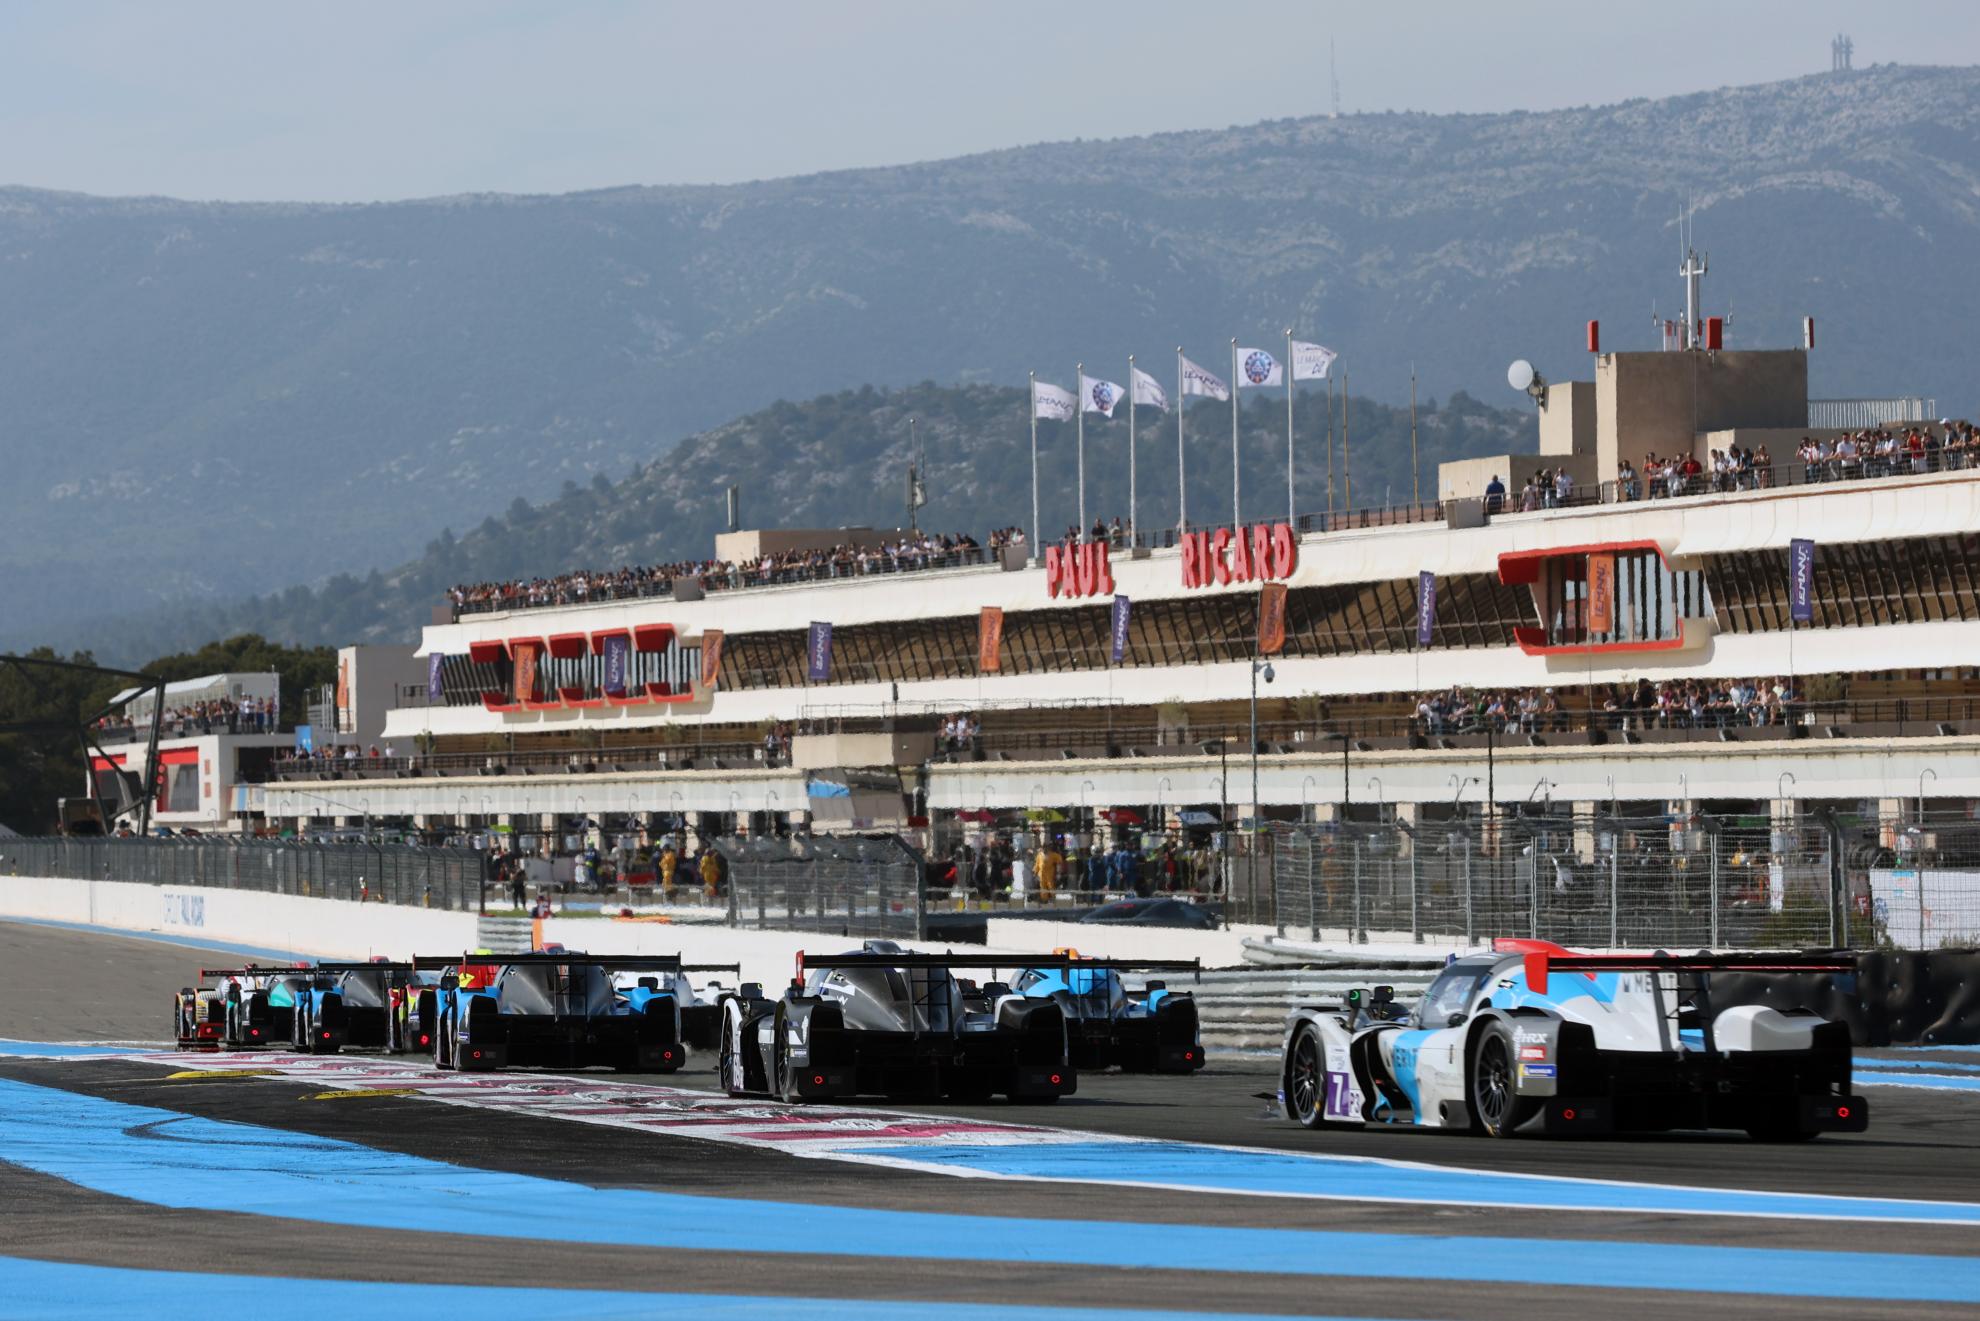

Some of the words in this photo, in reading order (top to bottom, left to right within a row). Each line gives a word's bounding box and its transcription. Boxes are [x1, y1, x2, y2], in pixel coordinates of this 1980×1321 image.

[1046, 542, 1114, 598] PAUL
[1181, 523, 1296, 588] RICARD
[1333, 1075, 1343, 1113] 7
